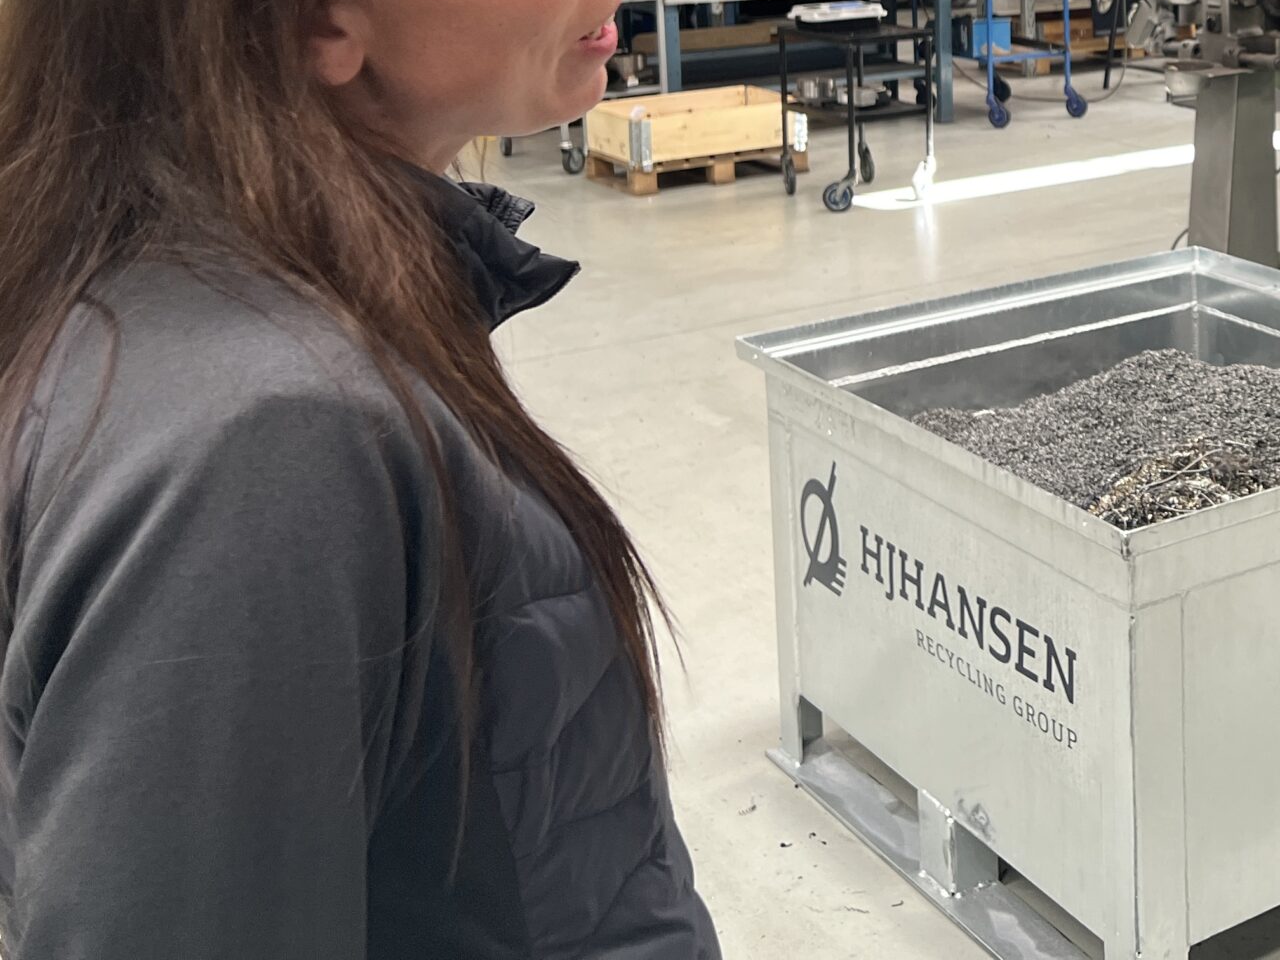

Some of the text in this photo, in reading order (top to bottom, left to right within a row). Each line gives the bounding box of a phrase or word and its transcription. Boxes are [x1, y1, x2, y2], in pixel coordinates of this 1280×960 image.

[860, 524, 1077, 705] HJHANSEN
[915, 628, 1078, 749] RECYCLING GROUP
